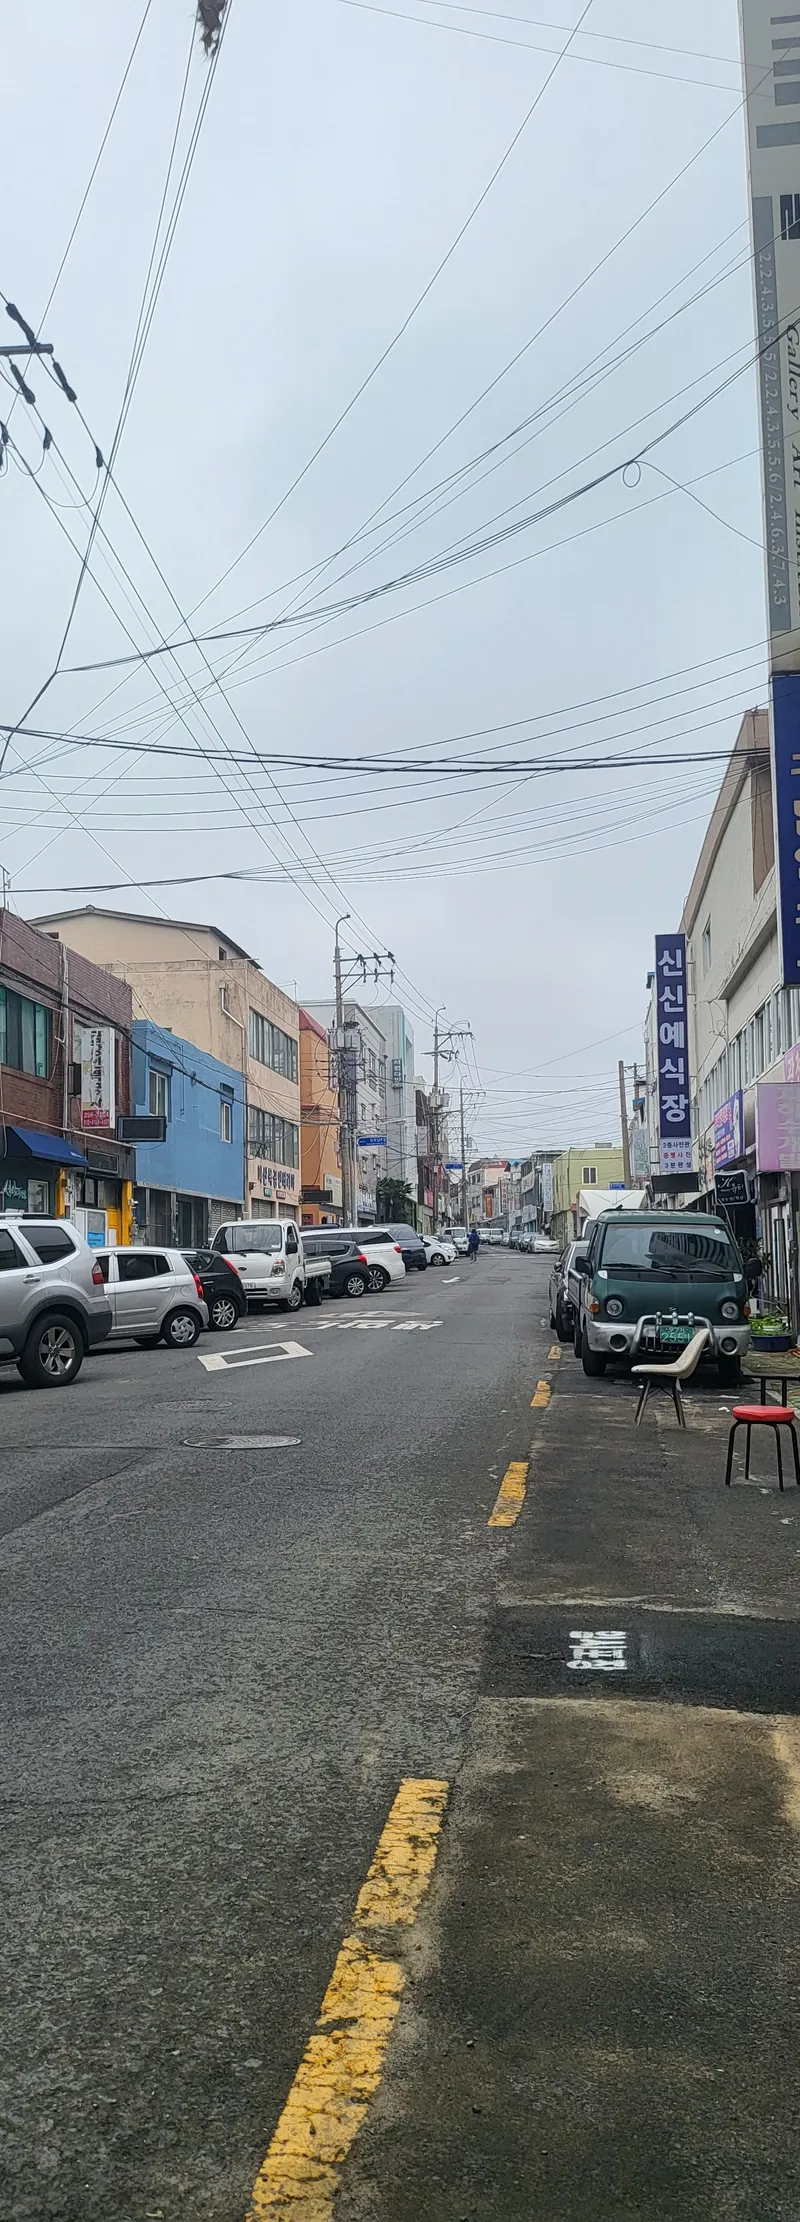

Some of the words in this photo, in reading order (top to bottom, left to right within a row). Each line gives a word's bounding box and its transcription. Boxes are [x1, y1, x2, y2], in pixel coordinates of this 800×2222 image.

[657, 948, 689, 1123] 신신예식장
[662, 1141, 690, 1149] 2층사진관
[661, 1332, 690, 1343] 2551
